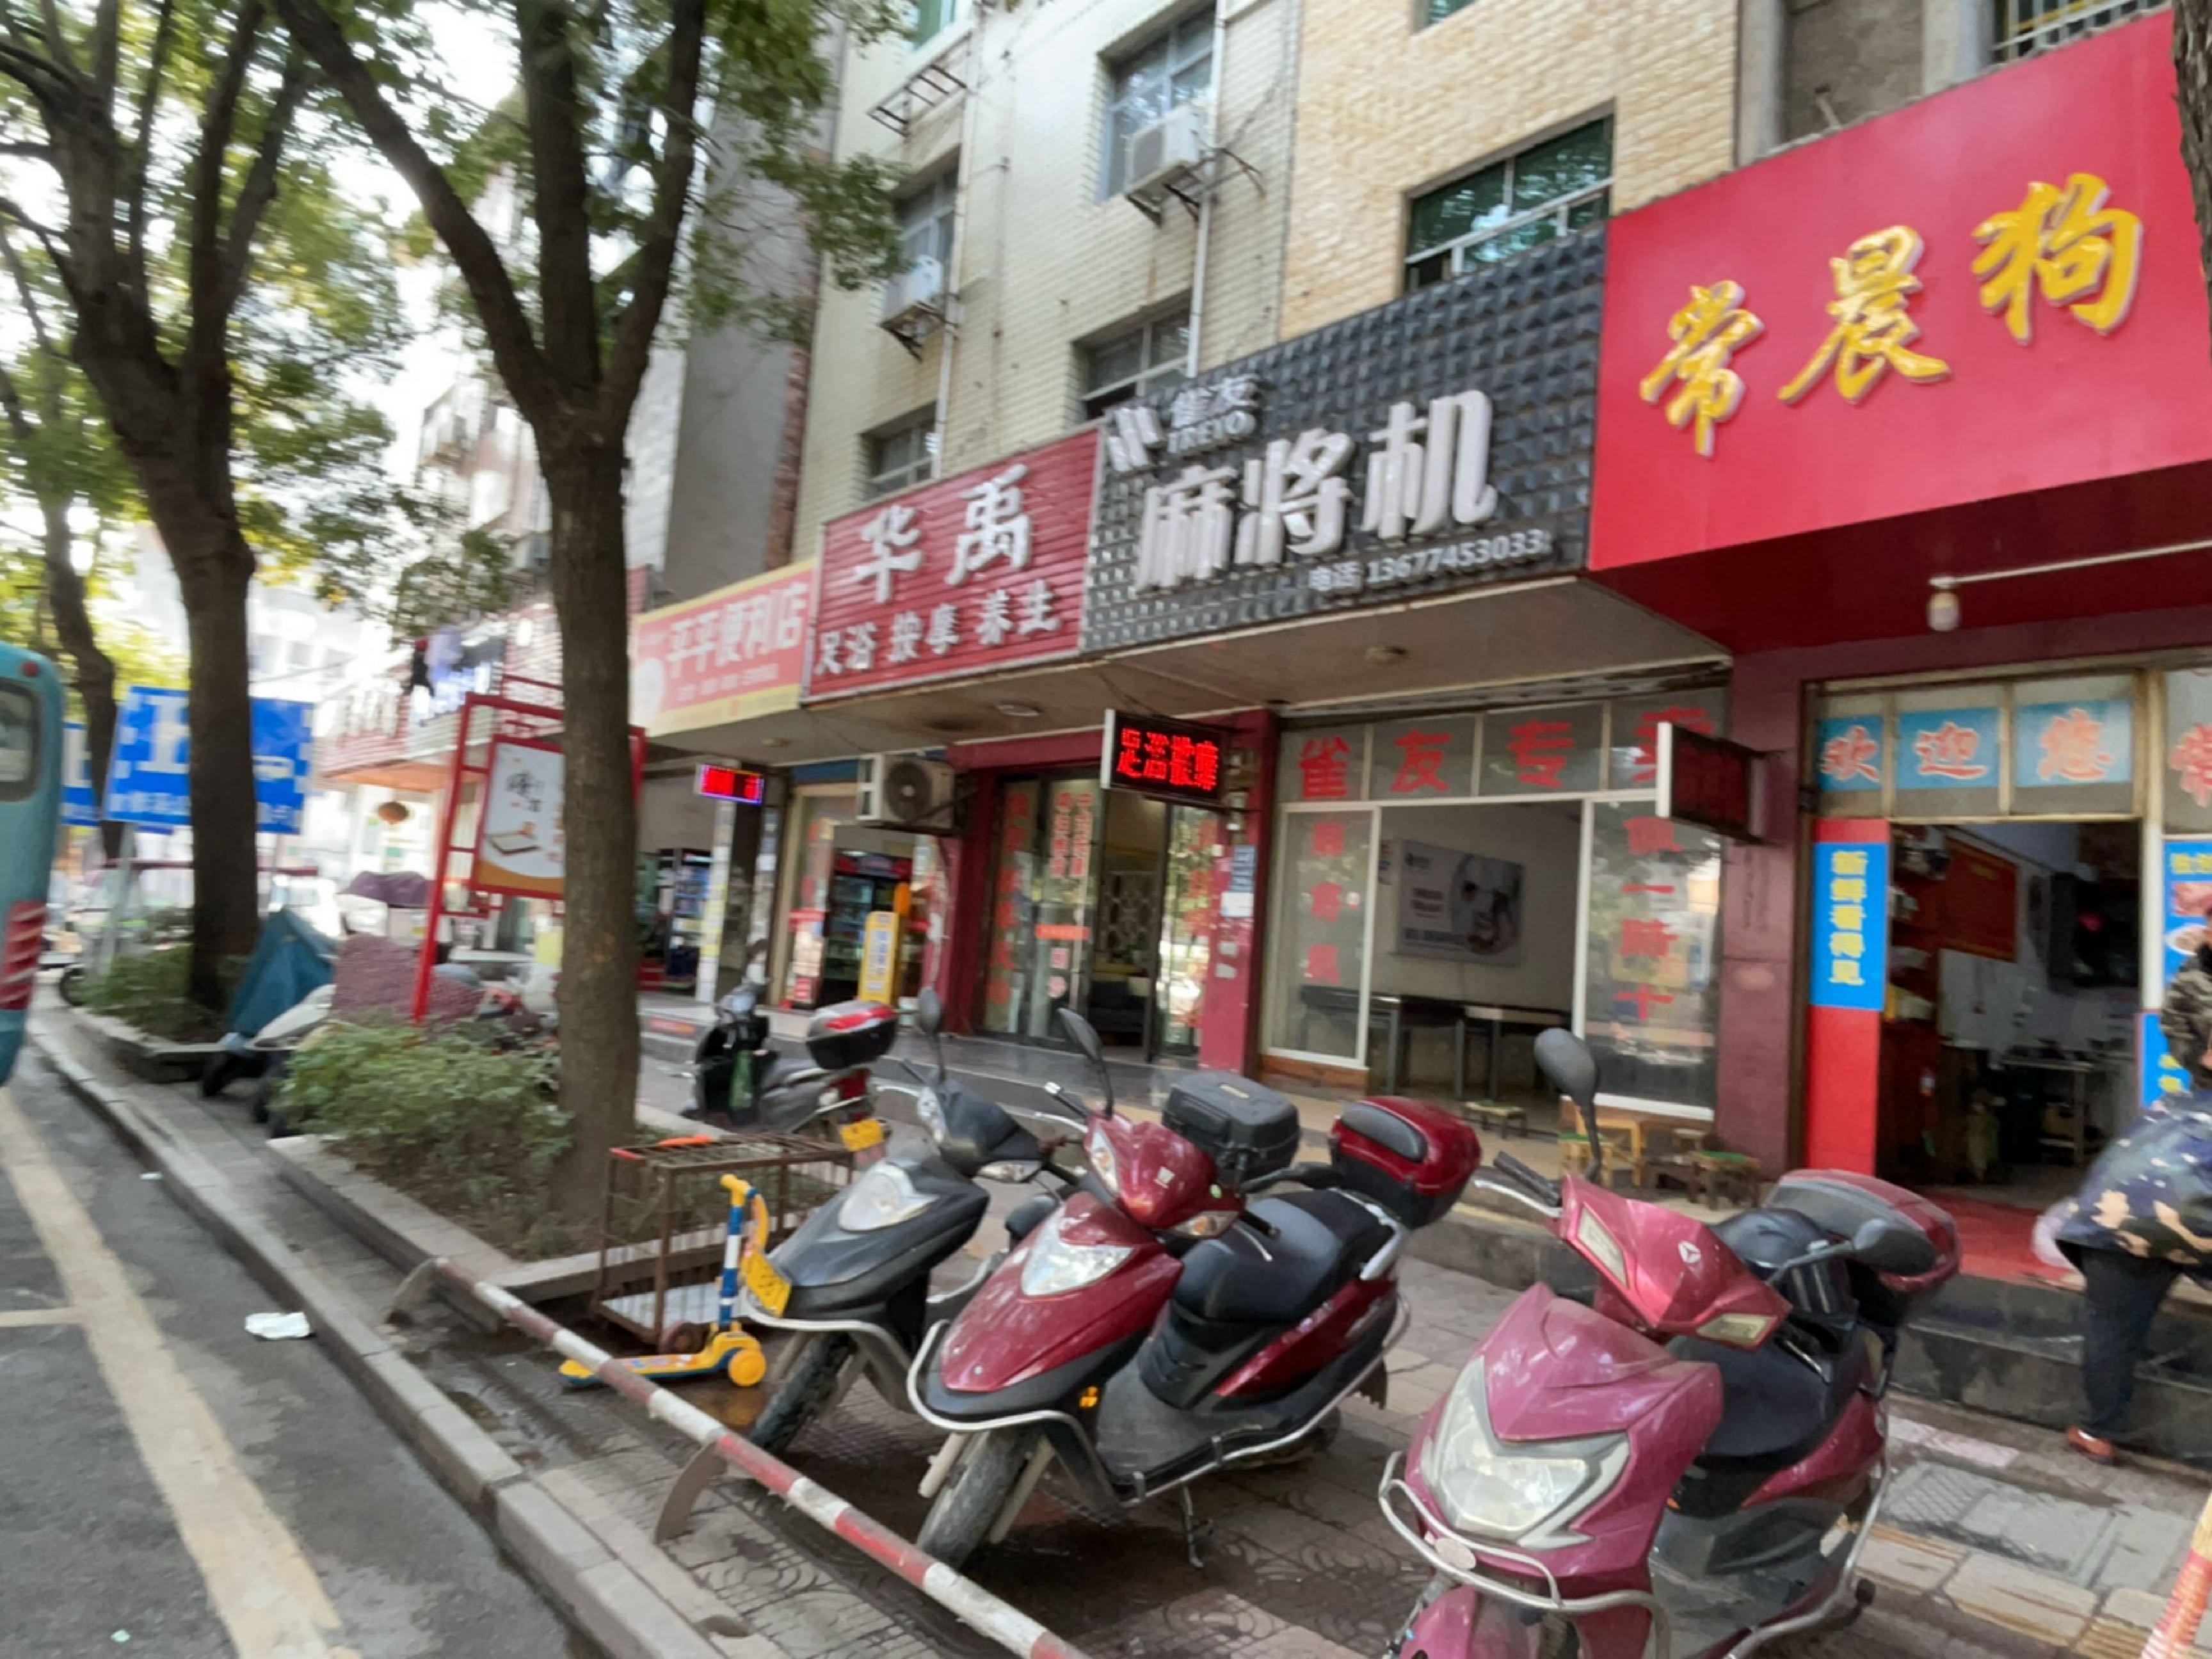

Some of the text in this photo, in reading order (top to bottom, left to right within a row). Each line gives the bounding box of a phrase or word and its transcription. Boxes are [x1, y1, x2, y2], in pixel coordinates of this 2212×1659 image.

[853, 463, 1033, 604] 华禹
[1136, 390, 1498, 593] 麻将机
[814, 579, 1062, 675] 足浴 按摩 养生
